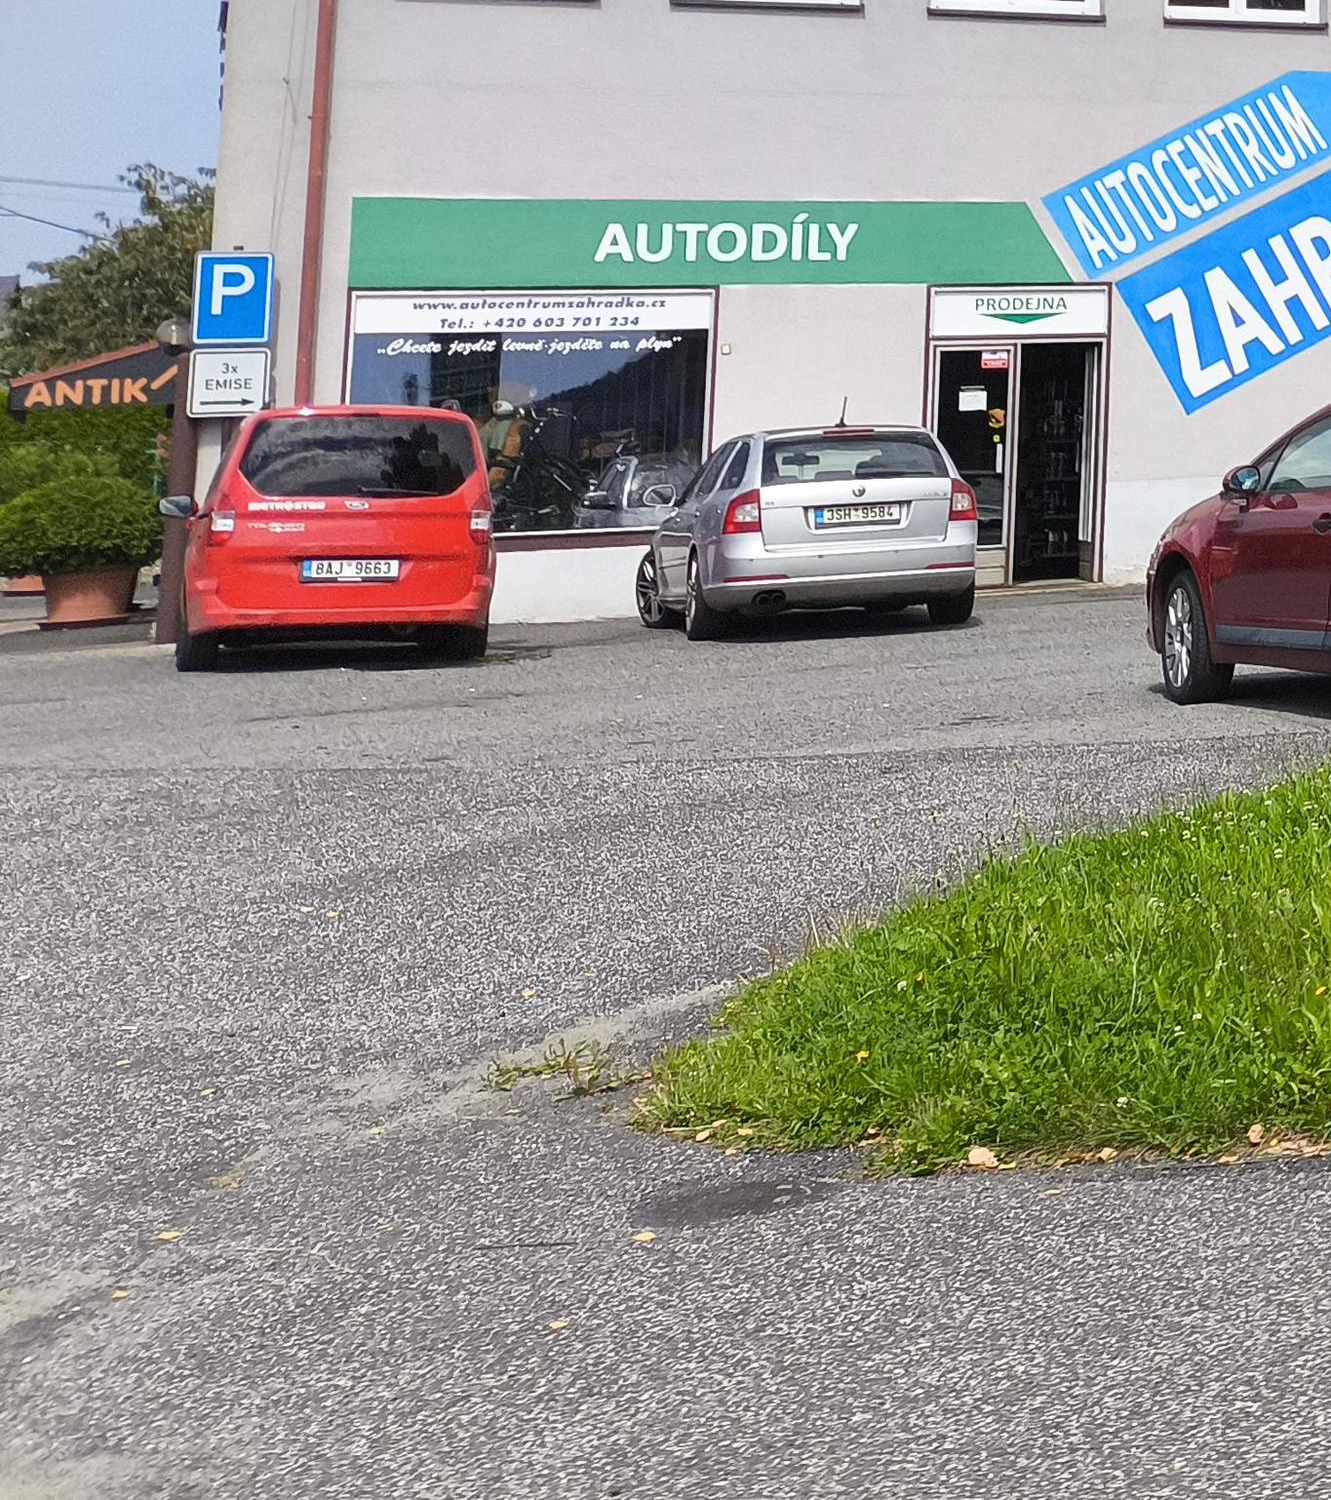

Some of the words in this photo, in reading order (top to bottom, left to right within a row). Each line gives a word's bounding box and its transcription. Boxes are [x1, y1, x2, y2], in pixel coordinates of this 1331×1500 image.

[1064, 84, 1328, 269] AUTOCENTRUM
[594, 213, 859, 264] AUTODÍLY
[211, 263, 256, 316] P
[412, 297, 667, 311] www.autocentrumzahradka.cz
[975, 296, 1068, 311] PRODEJNA
[440, 317, 475, 330] Tel.:
[482, 317, 526, 329] +420
[532, 317, 565, 328] 603
[571, 316, 602, 328] 701
[608, 316, 640, 327] 234
[221, 363, 239, 376] 3x
[205, 377, 253, 391] EMISE
[24, 377, 149, 410] ANTIK
[861, 505, 894, 519] 9584
[315, 562, 344, 576] 8AJ
[355, 561, 392, 575] 9663
